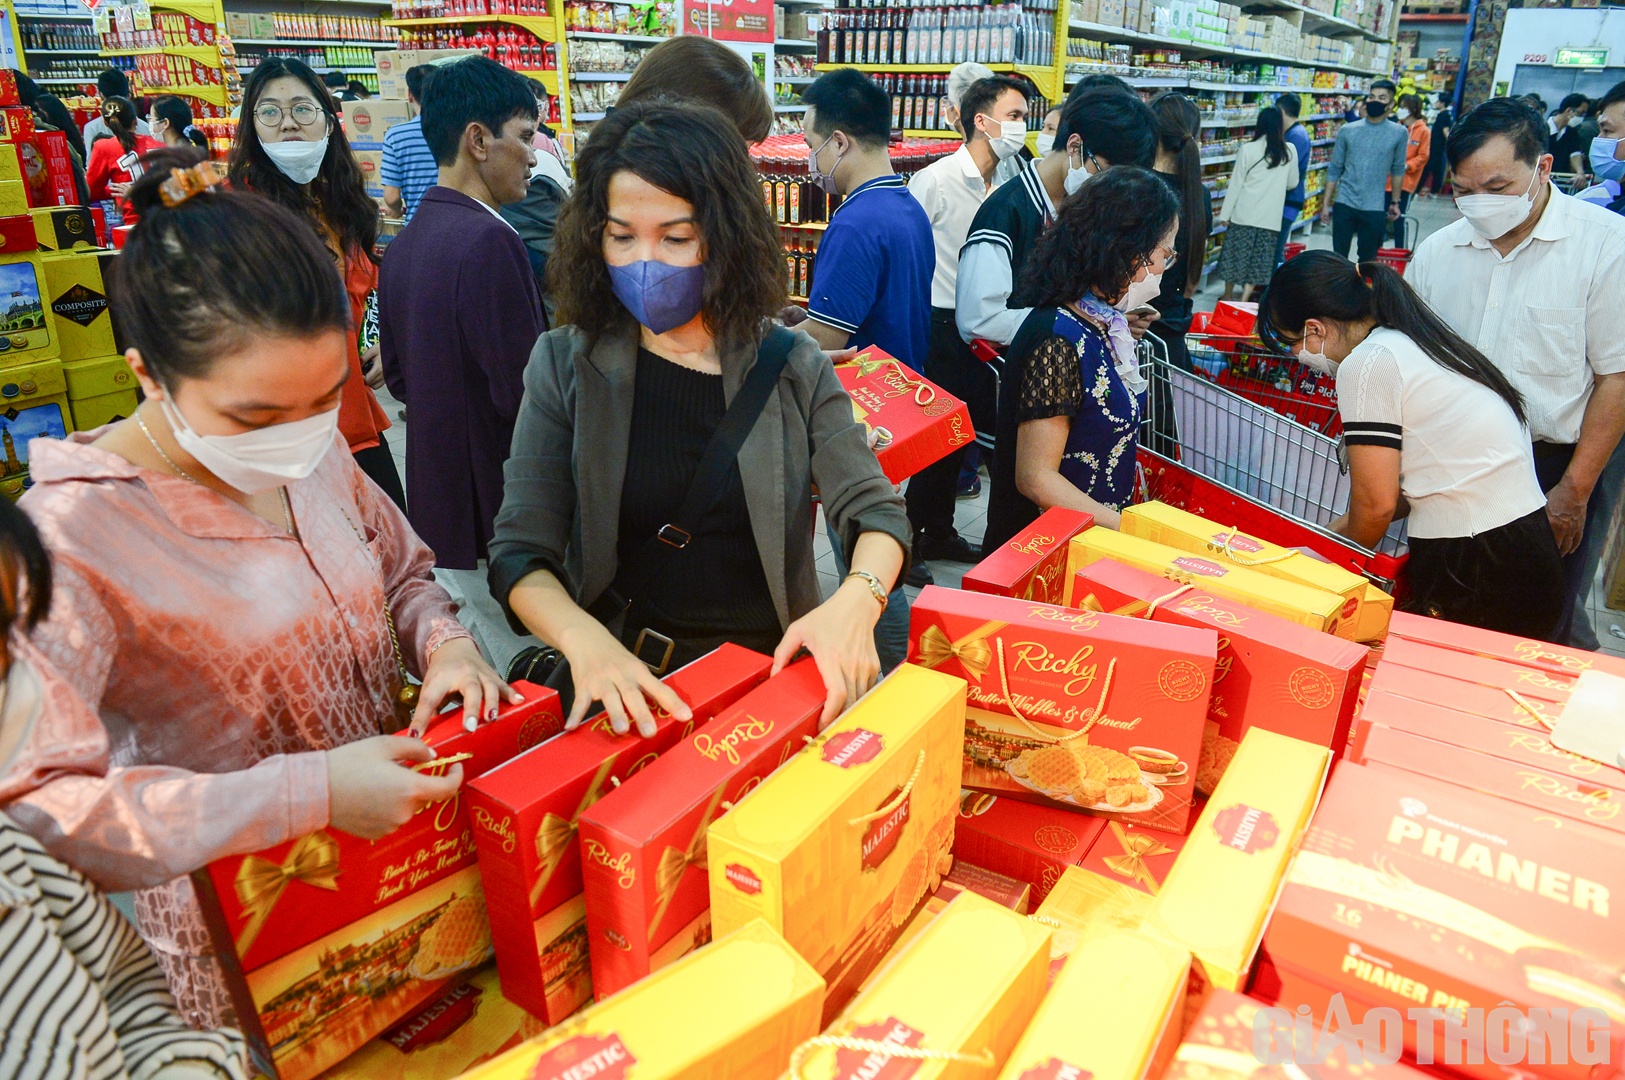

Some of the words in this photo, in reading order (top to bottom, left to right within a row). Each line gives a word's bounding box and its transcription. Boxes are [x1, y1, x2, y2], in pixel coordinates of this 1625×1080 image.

[54, 299, 107, 312] COMPOSITE
[876, 369, 913, 398] Richy
[948, 413, 970, 445] Richy
[1010, 533, 1055, 555] Richy
[1178, 558, 1225, 577] MAJESTIC
[1027, 606, 1100, 632] Richy
[1177, 595, 1249, 629] Richy
[1011, 641, 1098, 696] Richy
[1513, 641, 1594, 670] Richy
[1171, 675, 1191, 686] RICHY
[1301, 683, 1321, 692] RICHY
[967, 685, 1008, 707] Butter
[1007, 691, 1062, 718] Waffles
[1063, 705, 1079, 724] &
[1080, 707, 1142, 731] Otmeal
[694, 714, 774, 765] Richy
[830, 730, 873, 767] MAJESTIC
[1518, 771, 1621, 820] Richy
[472, 805, 516, 853] Richy
[862, 800, 909, 859] MAJESTIC
[1230, 807, 1262, 851] MAJESTIC
[584, 839, 635, 889] Richy
[726, 868, 761, 889] MAJESTIC
[1386, 815, 1611, 918] PHANER
[1333, 902, 1362, 924] 16
[1341, 954, 1429, 1004] PHANER
[1431, 989, 1471, 1021] PIE
[391, 984, 470, 1048] MAJESTIC
